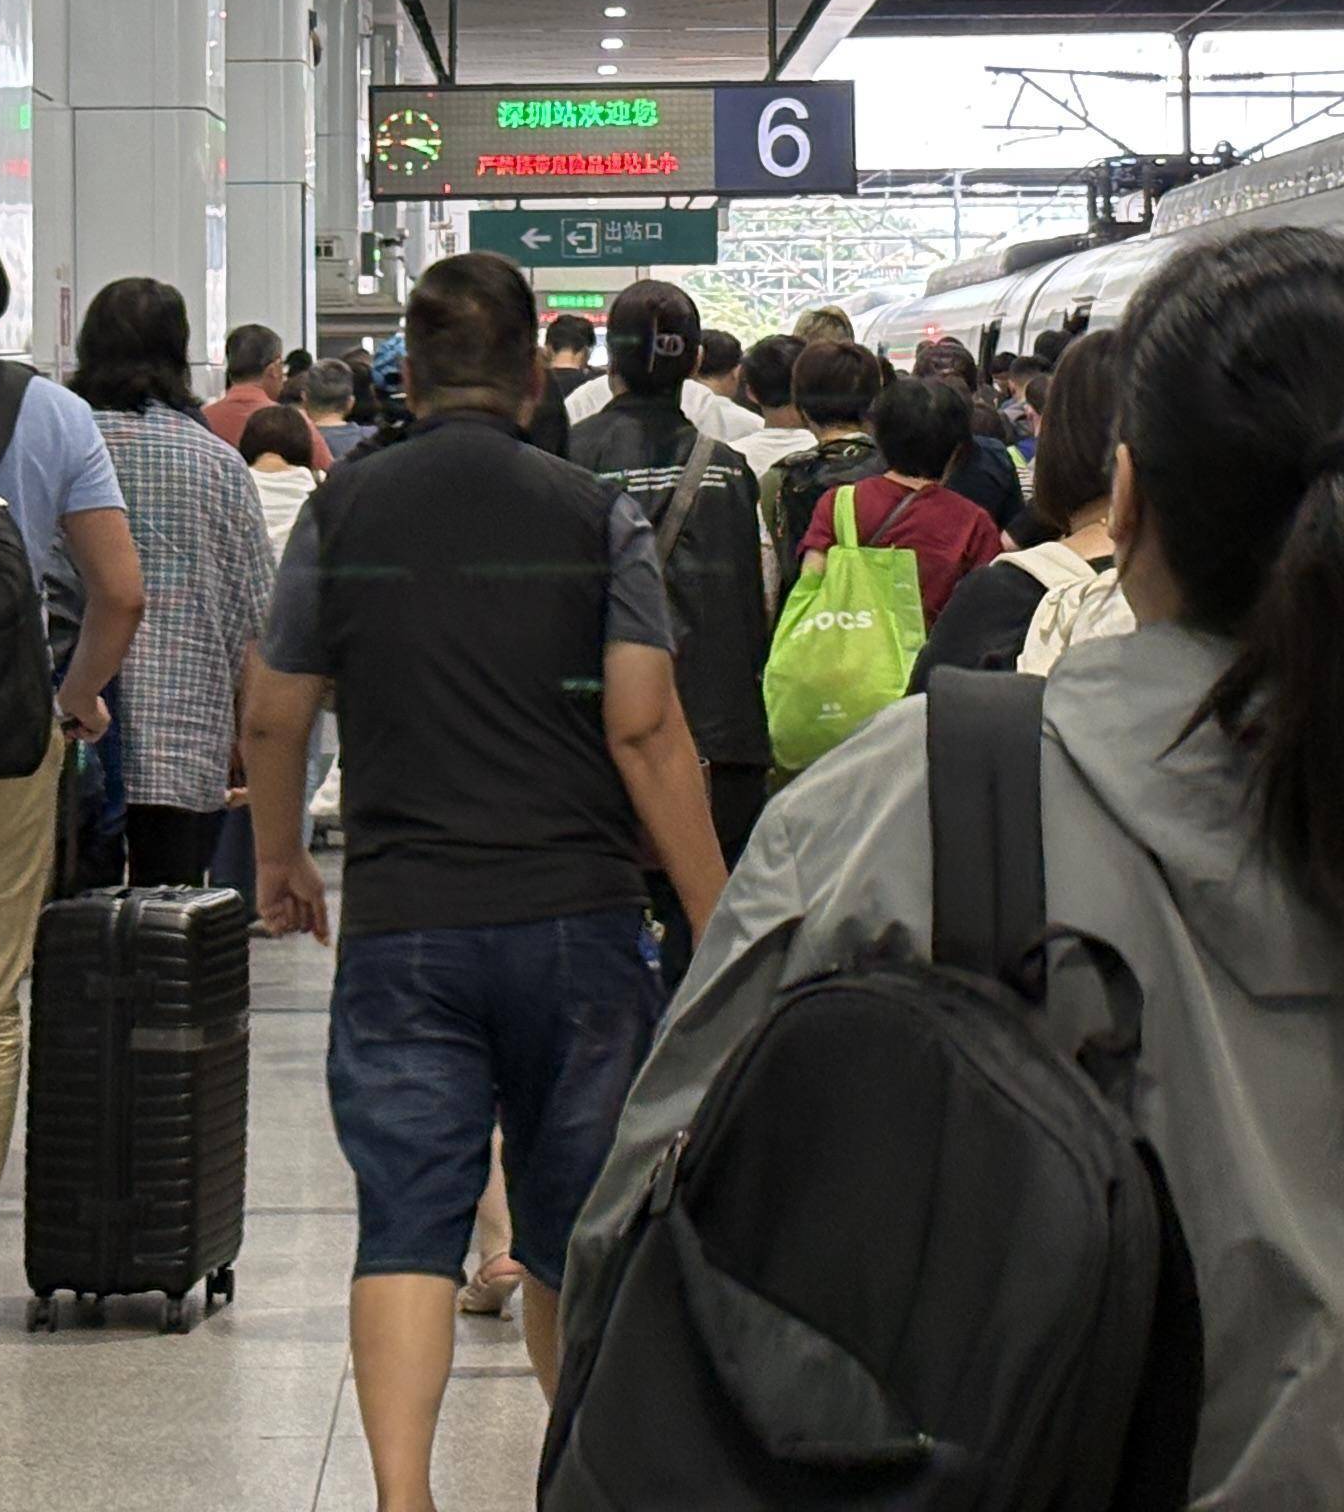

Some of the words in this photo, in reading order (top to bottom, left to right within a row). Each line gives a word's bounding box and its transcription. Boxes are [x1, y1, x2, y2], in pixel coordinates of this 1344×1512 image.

[497, 99, 661, 129] 深圳站欢迎您
[756, 96, 811, 178] 6
[604, 220, 663, 241] 出站口
